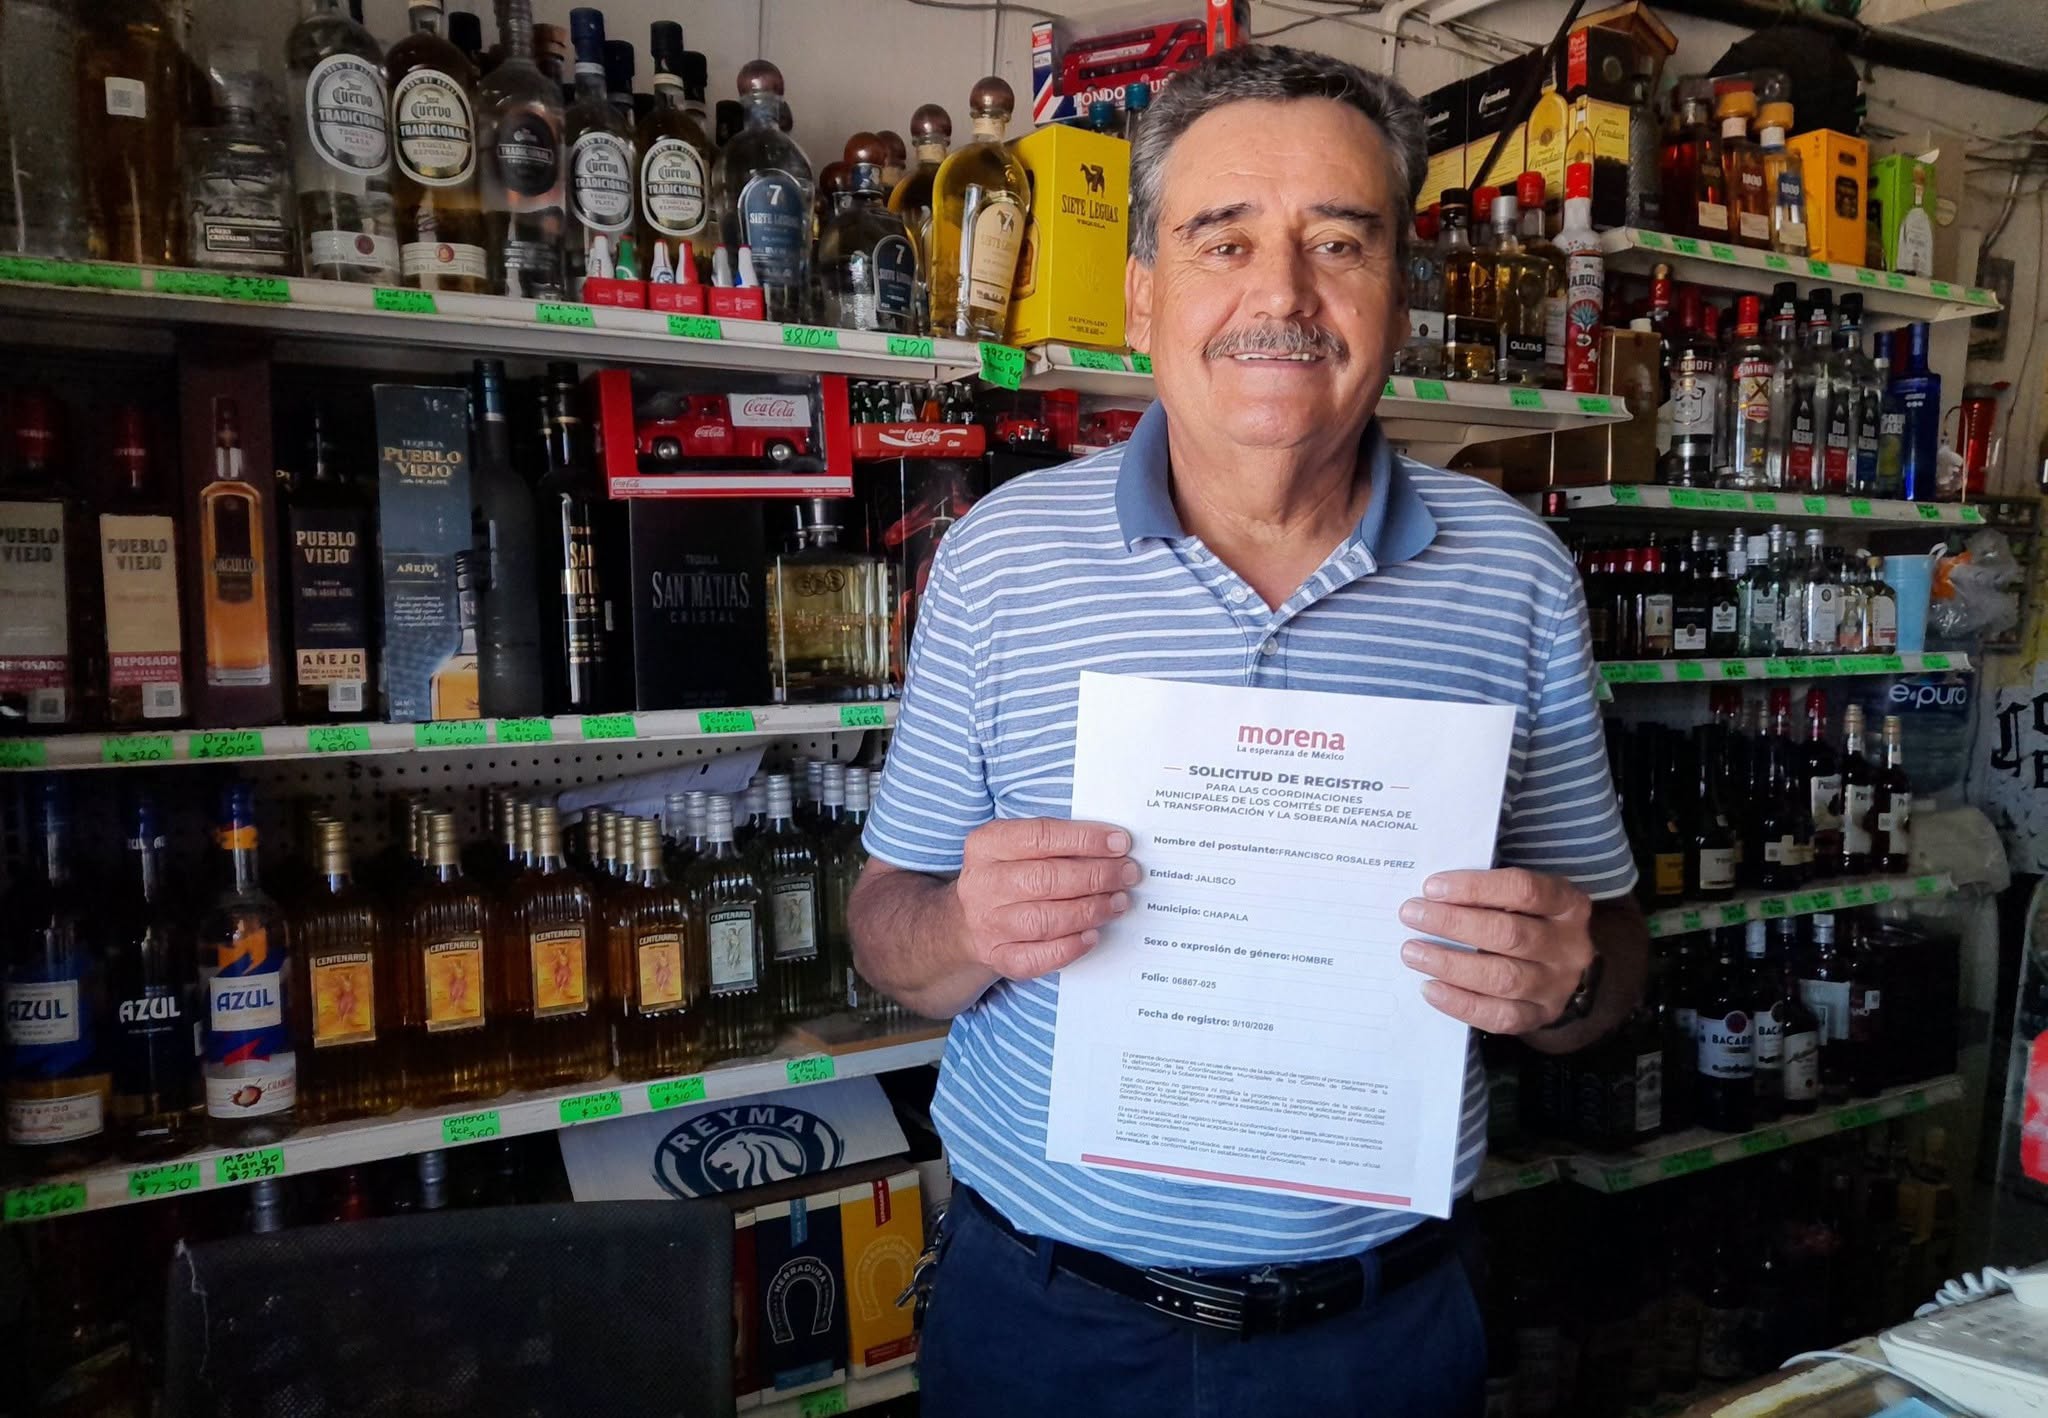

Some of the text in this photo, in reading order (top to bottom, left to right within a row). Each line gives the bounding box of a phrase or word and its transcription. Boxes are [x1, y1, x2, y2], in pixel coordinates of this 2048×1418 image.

[1073, 87, 1126, 107] LONDO
[400, 124, 467, 139] TRADICIONAL
[576, 177, 629, 192] TRADICIONAL
[648, 183, 702, 197] TRADICIONAL
[1061, 194, 1119, 223] SIETE LEGUAS
[1068, 316, 1108, 327] REPOSADO
[383, 446, 464, 464] PUEBLO
[395, 462, 453, 478] VIEJO
[108, 539, 168, 554] PUEBLO
[296, 530, 356, 547] PUEBLO
[4, 547, 54, 563] VIEJO
[117, 555, 162, 571] VIEJO
[304, 548, 351, 564] VIEJO
[652, 571, 752, 608] SAN MATIAS
[114, 656, 177, 668] REPOSADO
[302, 651, 361, 665] AÑEJO
[1237, 725, 1345, 751] morena
[1236, 744, 1344, 761] La esperanza de México
[1189, 765, 1383, 792] SOLICITUD DE REGISTRO
[1206, 783, 1363, 804] PARA LAS COORDINACIONES
[1155, 790, 1412, 819] MUNICIPALES DE LOS COMITÉS DE DEFENSA DE
[1147, 800, 1160, 808] LA
[1163, 801, 1265, 817] TRANSFORMACIÓN
[1277, 811, 1291, 819] LA
[1294, 812, 1358, 826] SOBERANÍA
[1360, 819, 1419, 831] NACIONAL
[1153, 836, 1196, 847] Nombre
[1198, 840, 1216, 849] del
[1336, 854, 1381, 866] ROSALES
[1383, 860, 1416, 869] PEREZ
[1149, 869, 1236, 886] Entidad: JALISCO
[710, 911, 751, 922] CENTENARIO
[1147, 903, 1249, 922] Municipio: CHAPALA
[536, 928, 581, 941] CENTENARIO
[639, 933, 679, 945] CENTENARIO
[430, 940, 478, 953] CENTENARIO
[1144, 937, 1168, 947] Sexo
[1180, 942, 1231, 954] expresión
[1234, 947, 1247, 956] de
[1249, 950, 1290, 961] género:
[1291, 954, 1334, 966] HOMBRE
[316, 953, 368, 966] CENTENARIO
[1141, 972, 1217, 989] Folio: 06867-025
[216, 988, 274, 1012] AZUL
[7, 1000, 69, 1021] AZUL
[119, 996, 181, 1024] AZUL
[1138, 1008, 1274, 1032] Fecha de registro: 9/10/2026
[1712, 1034, 1753, 1045] BACARD
[668, 1106, 804, 1154] REYMA
[774, 1264, 827, 1293] HERRADURA
